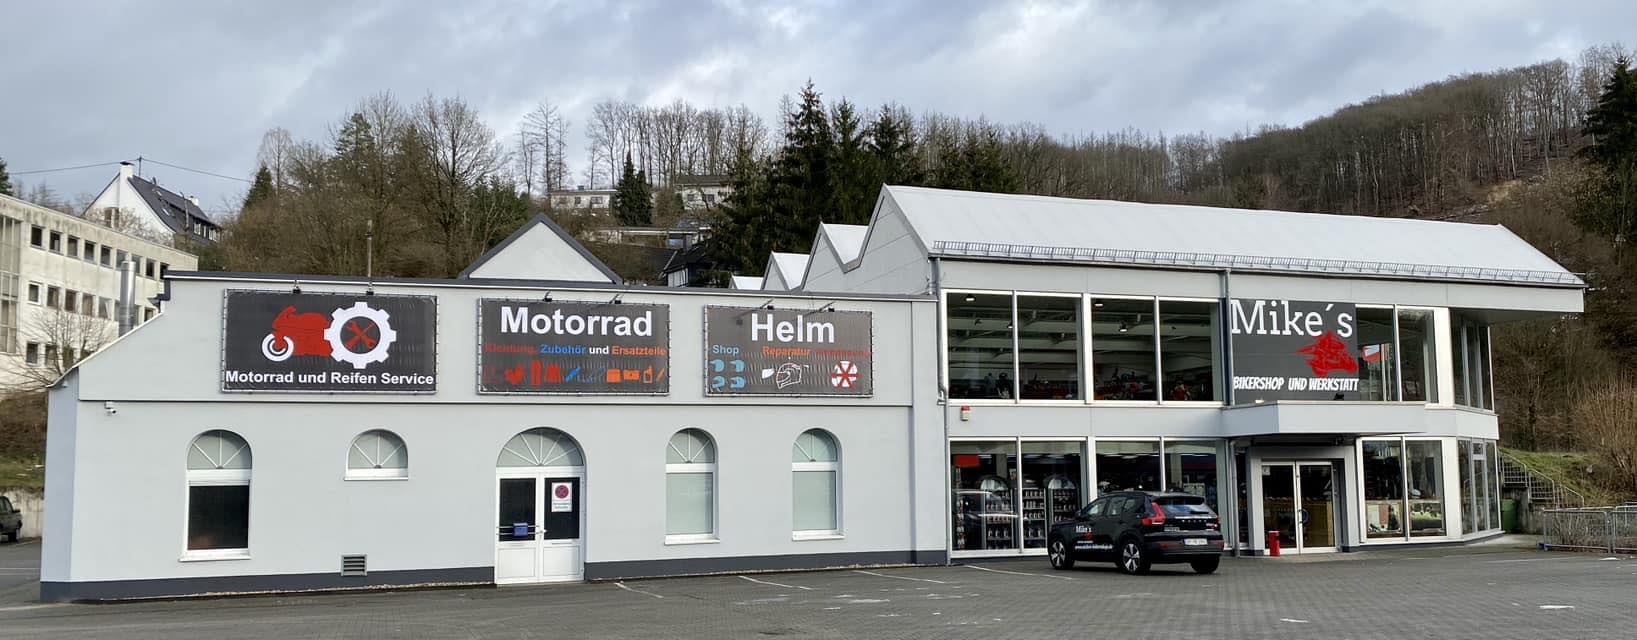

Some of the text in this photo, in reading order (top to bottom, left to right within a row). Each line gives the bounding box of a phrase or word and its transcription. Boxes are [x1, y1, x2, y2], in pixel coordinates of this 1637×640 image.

[500, 306, 652, 336] Motorrad
[751, 313, 834, 343] Helm
[540, 344, 586, 355] Zubehör
[589, 345, 609, 355] und
[611, 345, 667, 356] Ersatzteile
[712, 344, 739, 356] Shop
[762, 346, 811, 357] Reparatur
[225, 370, 434, 385] Motorrad und Reifen Service
[1233, 376, 1360, 391] BIKERSHOP UND WERKSTATT
